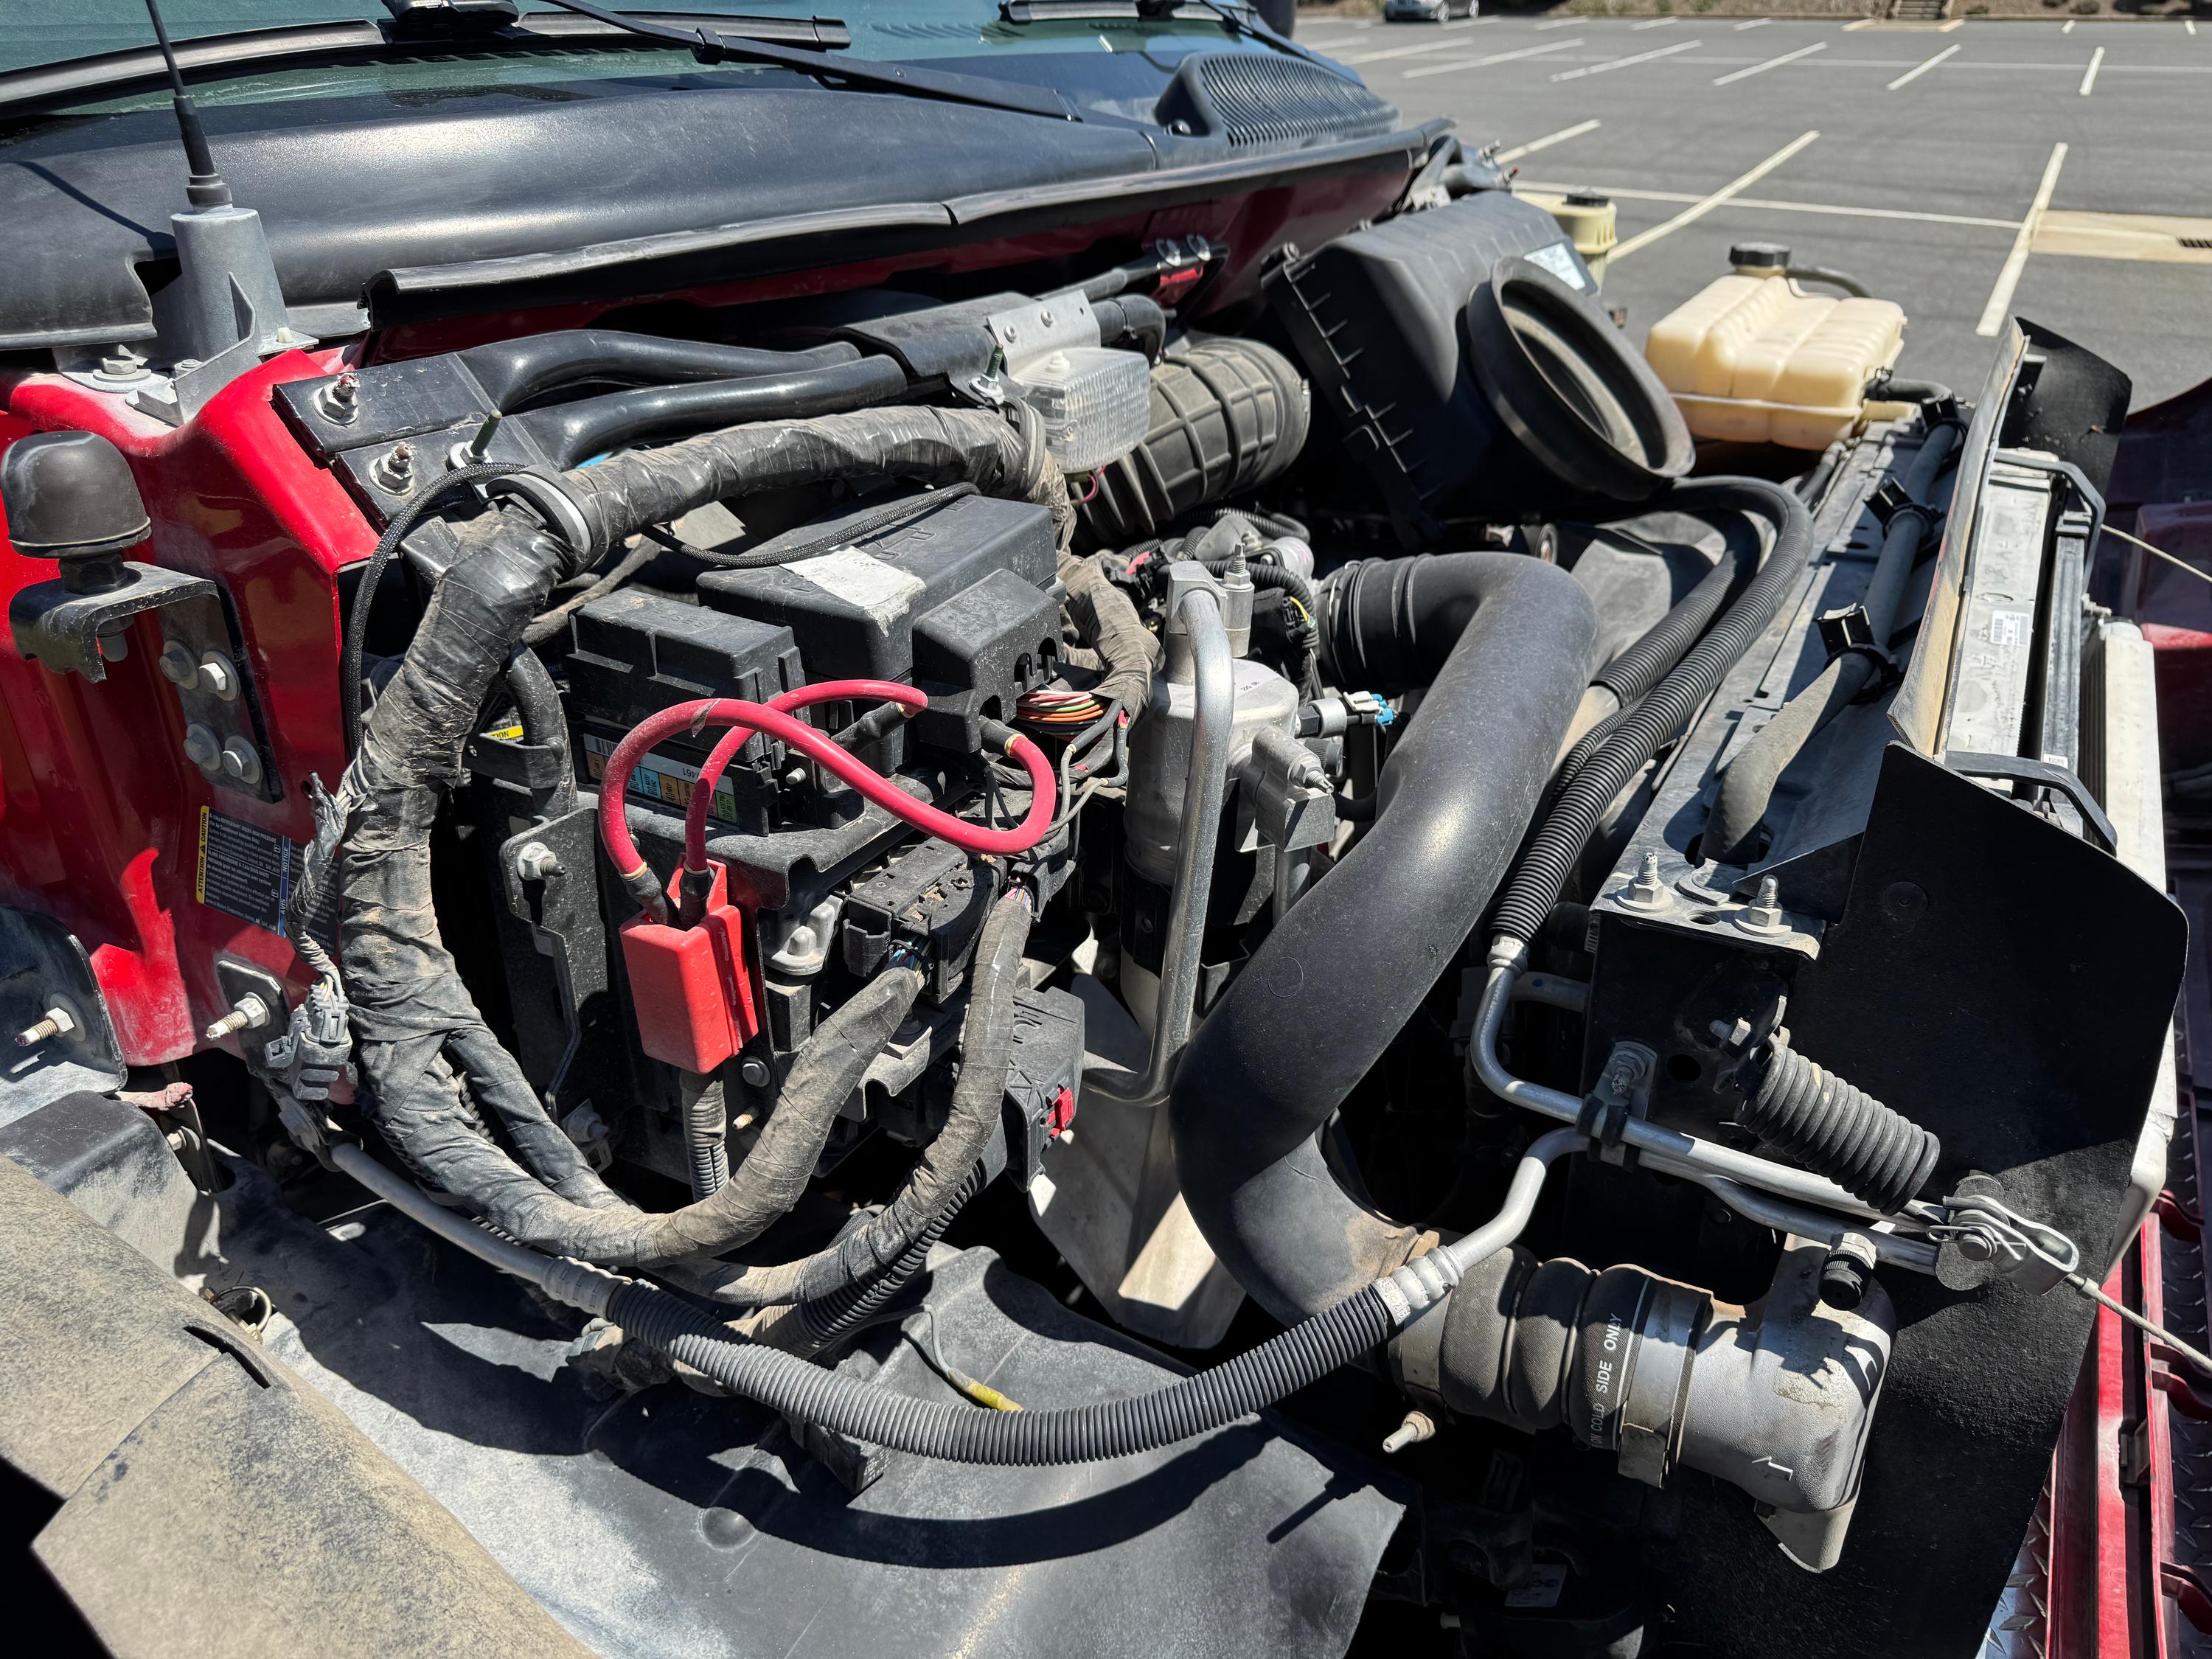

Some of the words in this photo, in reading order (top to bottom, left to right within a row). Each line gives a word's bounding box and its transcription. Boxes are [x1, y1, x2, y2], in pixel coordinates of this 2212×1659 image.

[1603, 1312, 1622, 1351] ONLY
[1596, 1360, 1613, 1394] SIDE
[1590, 1402, 1605, 1431] COLD
